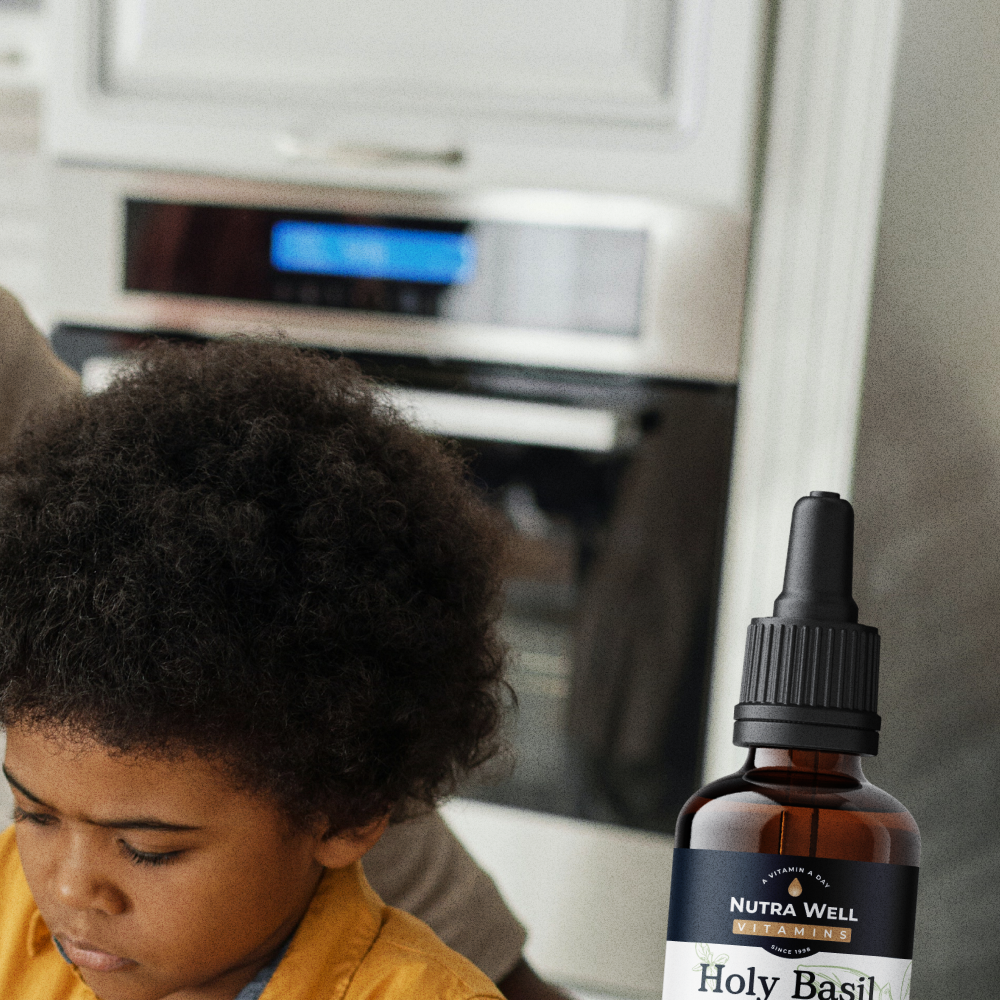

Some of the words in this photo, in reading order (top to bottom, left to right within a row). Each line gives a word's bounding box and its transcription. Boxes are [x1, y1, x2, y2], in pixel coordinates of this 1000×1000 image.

[768, 866, 805, 879] VITAMIN
[815, 874, 830, 888] DAY
[737, 922, 847, 940] VITAMINS
[770, 944, 792, 955] SINCE
